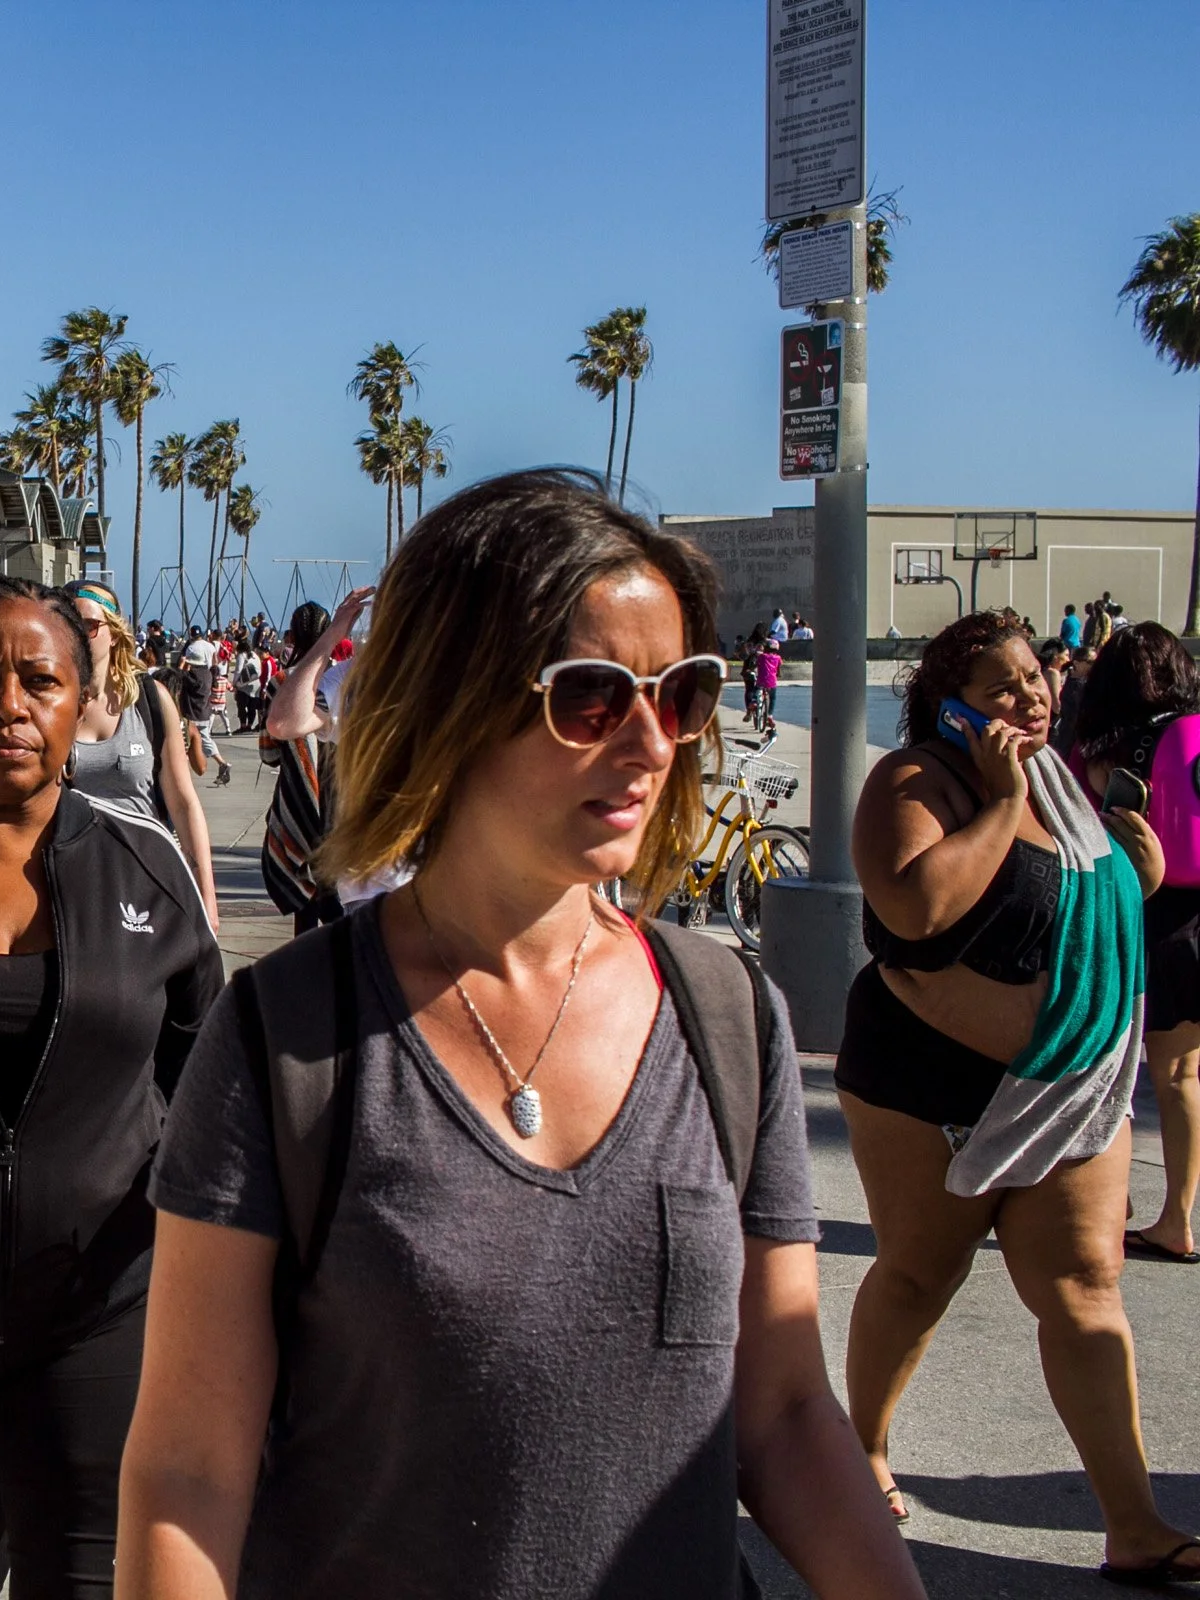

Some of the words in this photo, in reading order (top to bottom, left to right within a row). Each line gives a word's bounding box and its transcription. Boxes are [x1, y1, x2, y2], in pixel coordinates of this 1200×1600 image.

[799, 34, 814, 44] BEACH
[802, 232, 817, 241] BEACH
[791, 416, 800, 425] No
[802, 414, 831, 424] Smoking
[784, 426, 814, 436] Anywhere
[822, 422, 836, 431] Park
[787, 447, 797, 456] No
[122, 921, 154, 933] adidas
